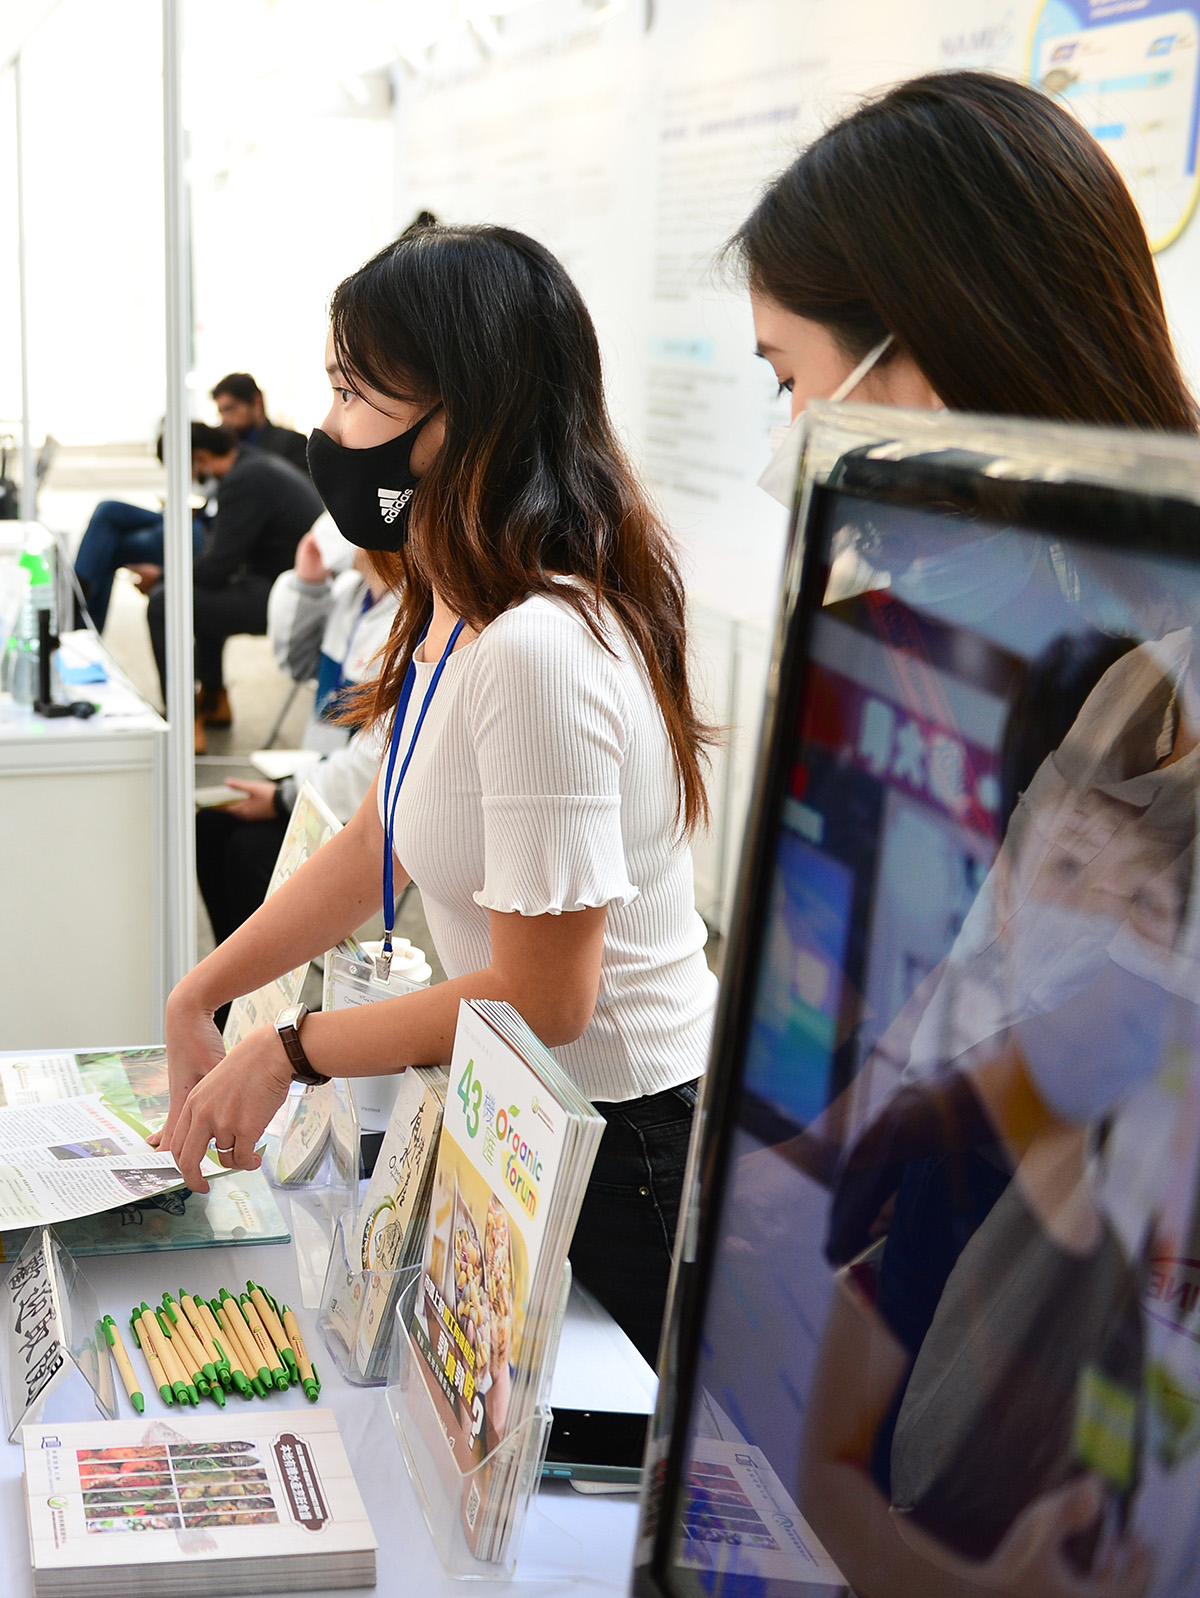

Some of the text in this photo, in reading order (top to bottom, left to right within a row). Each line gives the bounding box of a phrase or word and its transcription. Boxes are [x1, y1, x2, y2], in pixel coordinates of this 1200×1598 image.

[384, 488, 414, 524] adidas
[457, 1058, 482, 1139] 43
[495, 1107, 544, 1182] Organic
[505, 1155, 537, 1217] forum
[8, 1249, 64, 1407] 歡迎取閱
